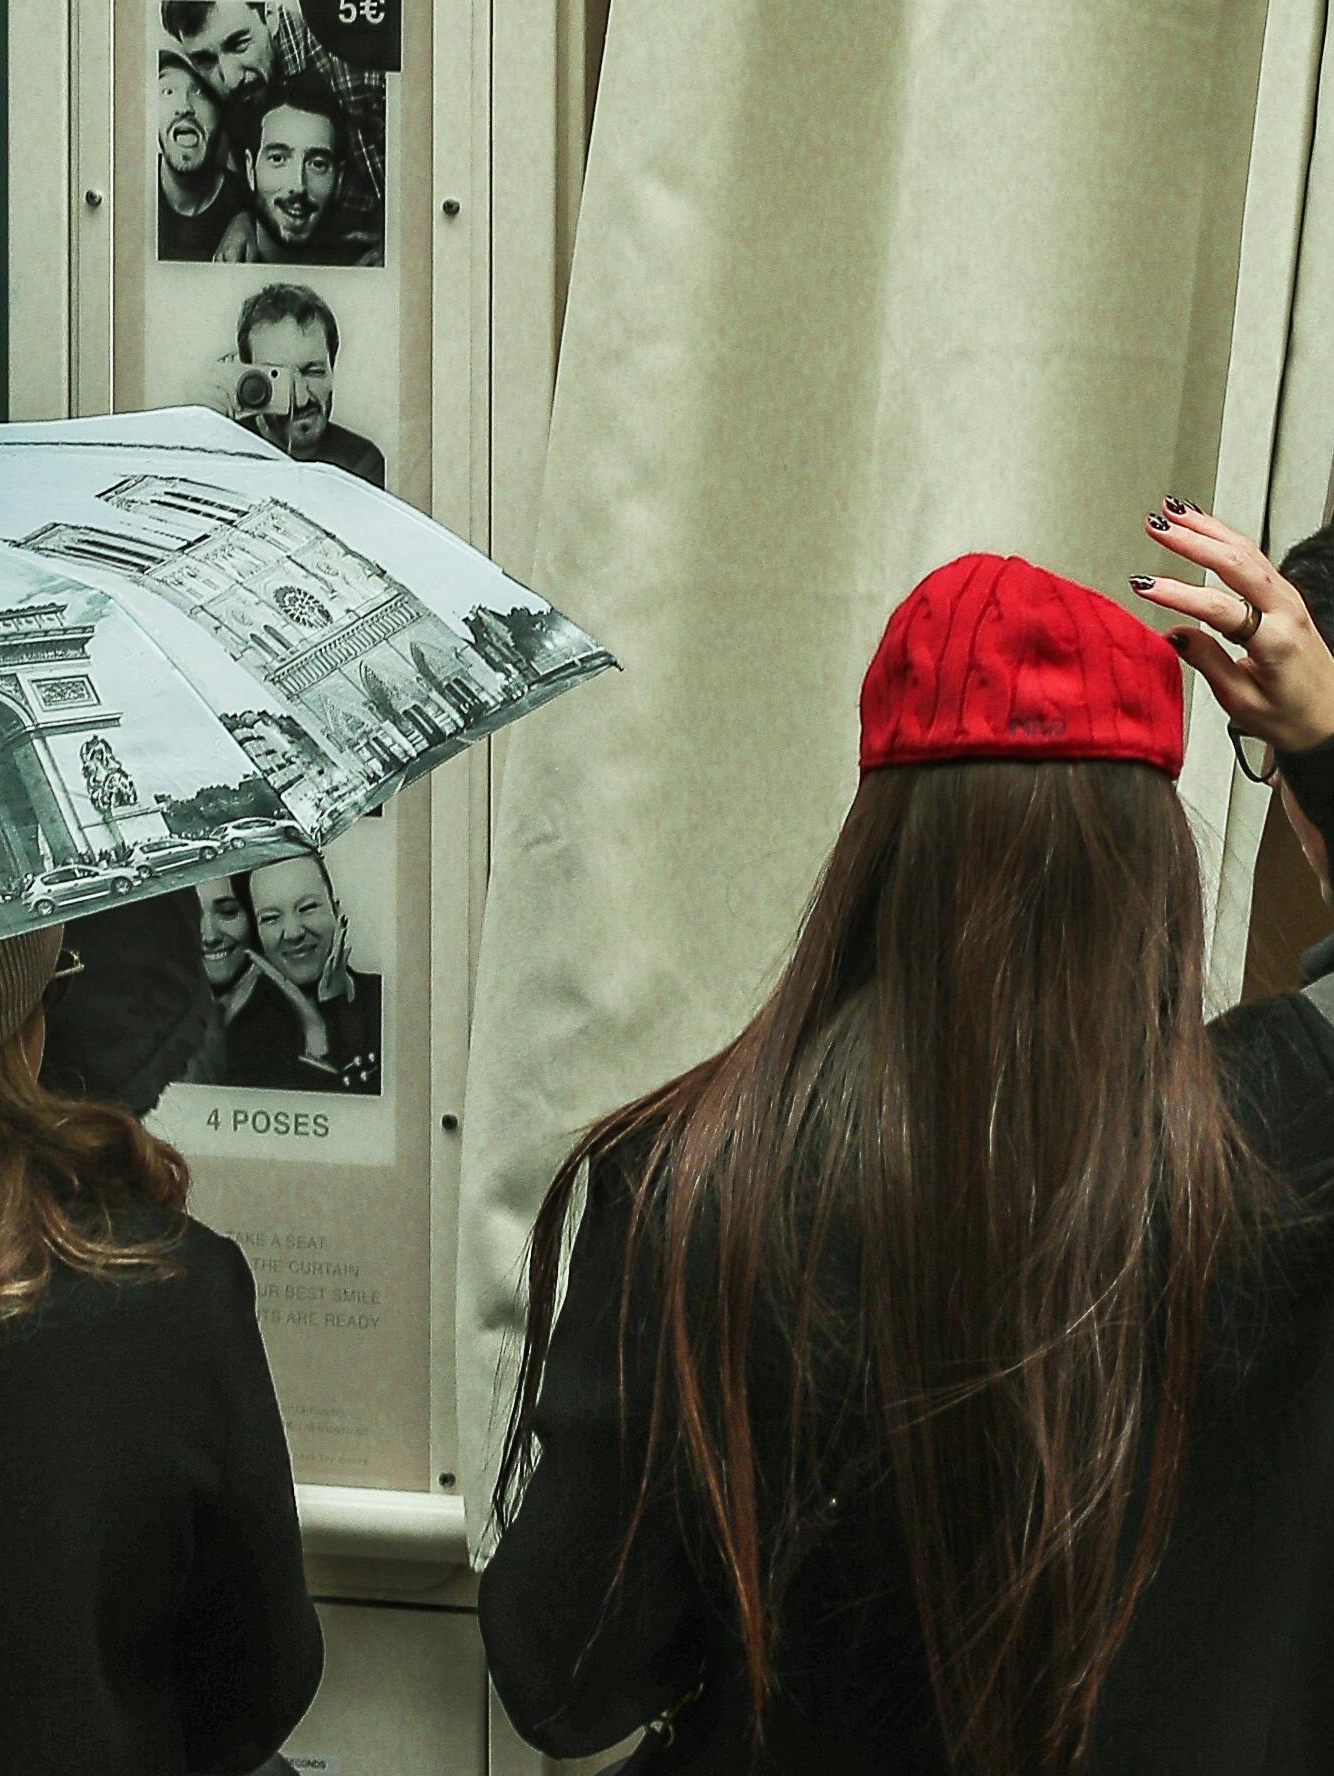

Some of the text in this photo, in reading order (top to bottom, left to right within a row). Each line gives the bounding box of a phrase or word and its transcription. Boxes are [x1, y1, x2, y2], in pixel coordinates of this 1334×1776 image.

[206, 1107, 330, 1138] 4 POSES
[286, 1234, 327, 1250] SEAT
[288, 1260, 360, 1278] CURTAIN
[258, 1284, 382, 1305] UR BEST SMILE
[286, 1310, 318, 1327] ARE
[325, 1312, 381, 1330] READY
